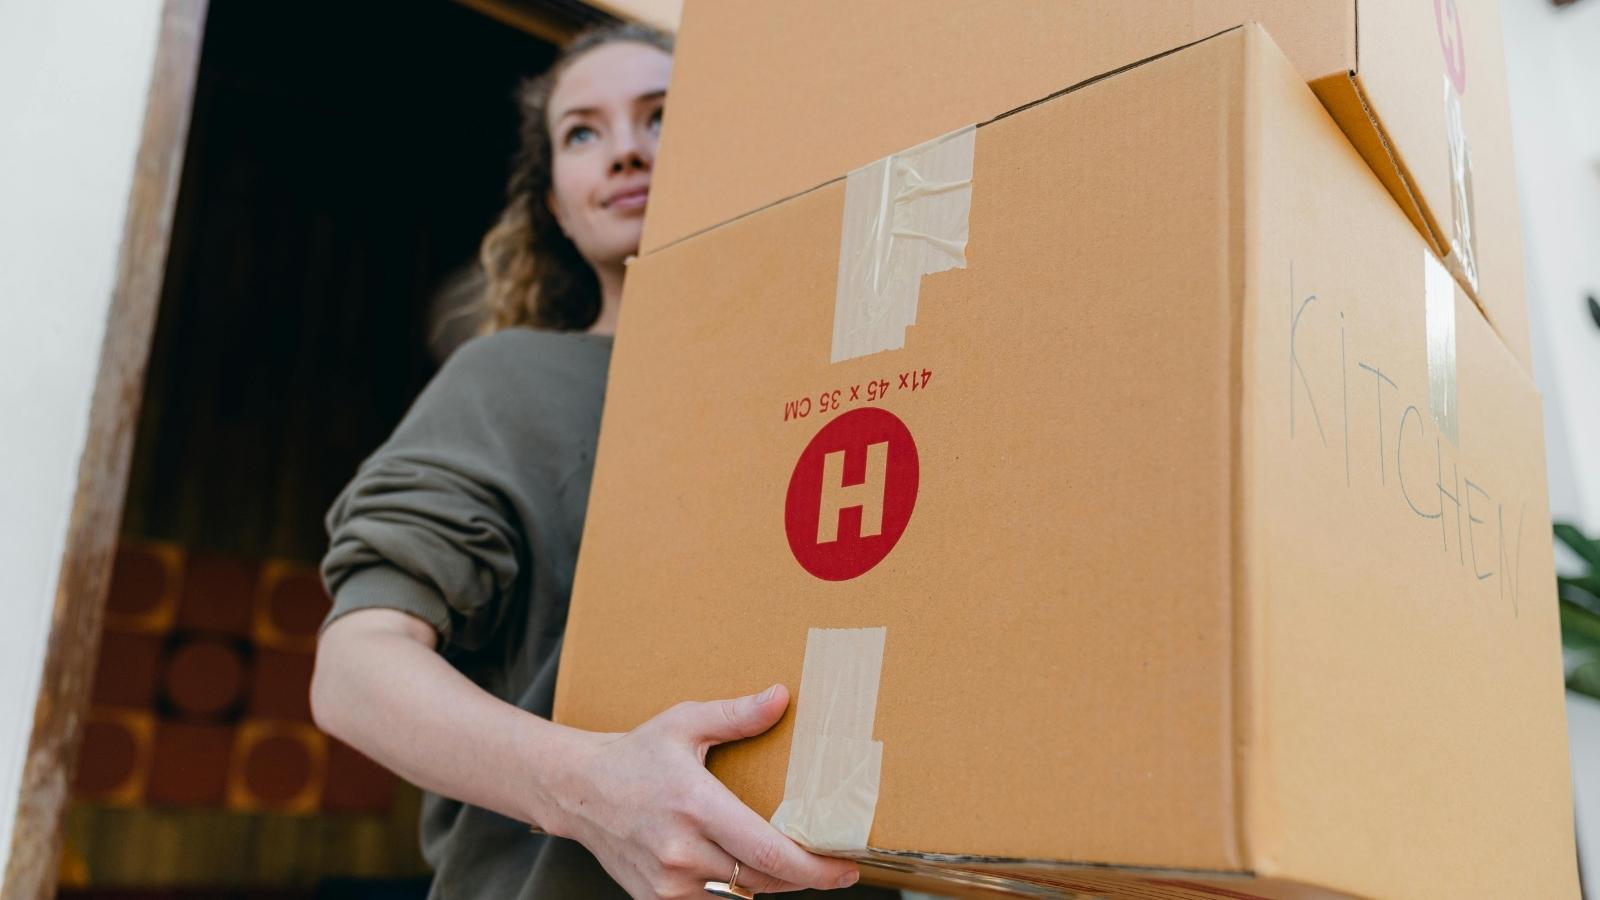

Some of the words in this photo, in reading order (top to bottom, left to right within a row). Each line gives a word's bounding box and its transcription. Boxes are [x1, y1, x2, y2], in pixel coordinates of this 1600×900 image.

[819, 389, 841, 413] 35
[867, 379, 889, 401] 45
[784, 397, 811, 421] CM
[816, 440, 889, 544] H
